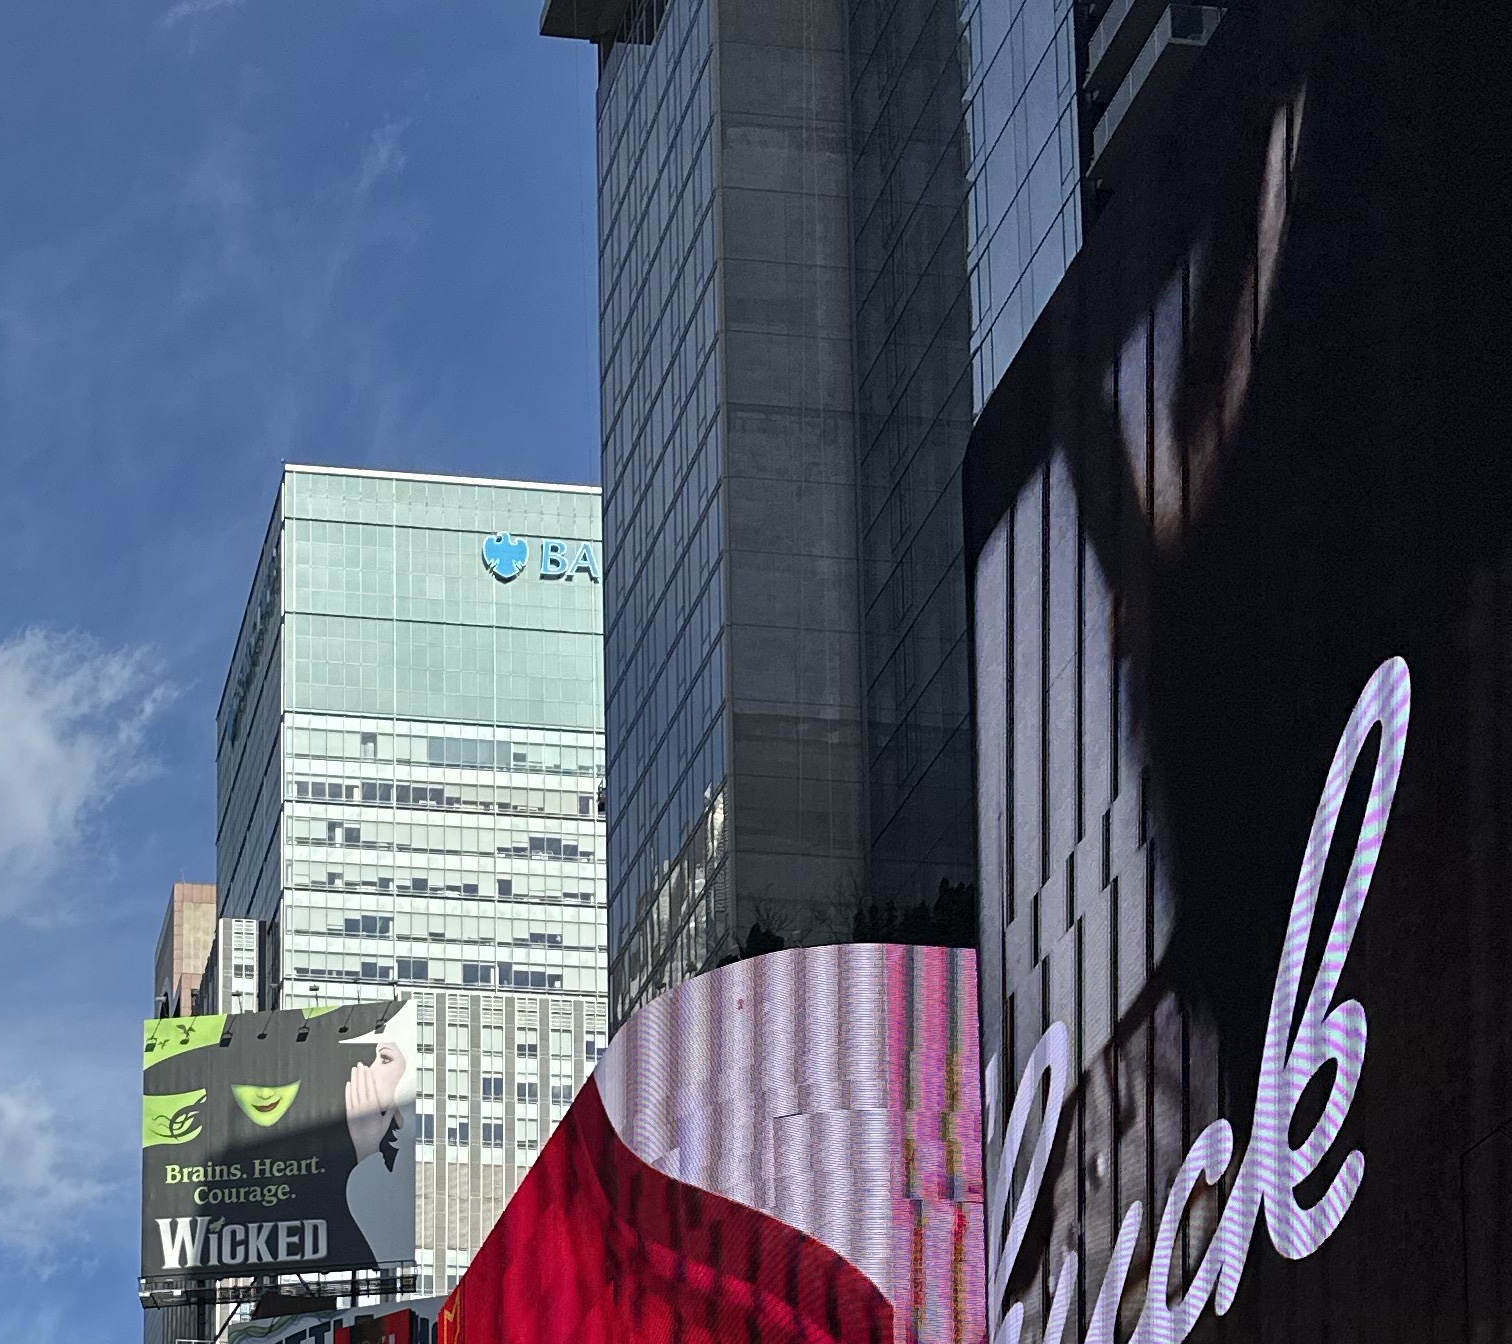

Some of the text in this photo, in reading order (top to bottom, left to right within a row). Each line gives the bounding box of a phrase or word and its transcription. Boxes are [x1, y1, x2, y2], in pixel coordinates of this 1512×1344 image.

[540, 538, 601, 581] BA
[165, 1155, 326, 1185] Brains. Heart.
[192, 1183, 297, 1208] Courage.
